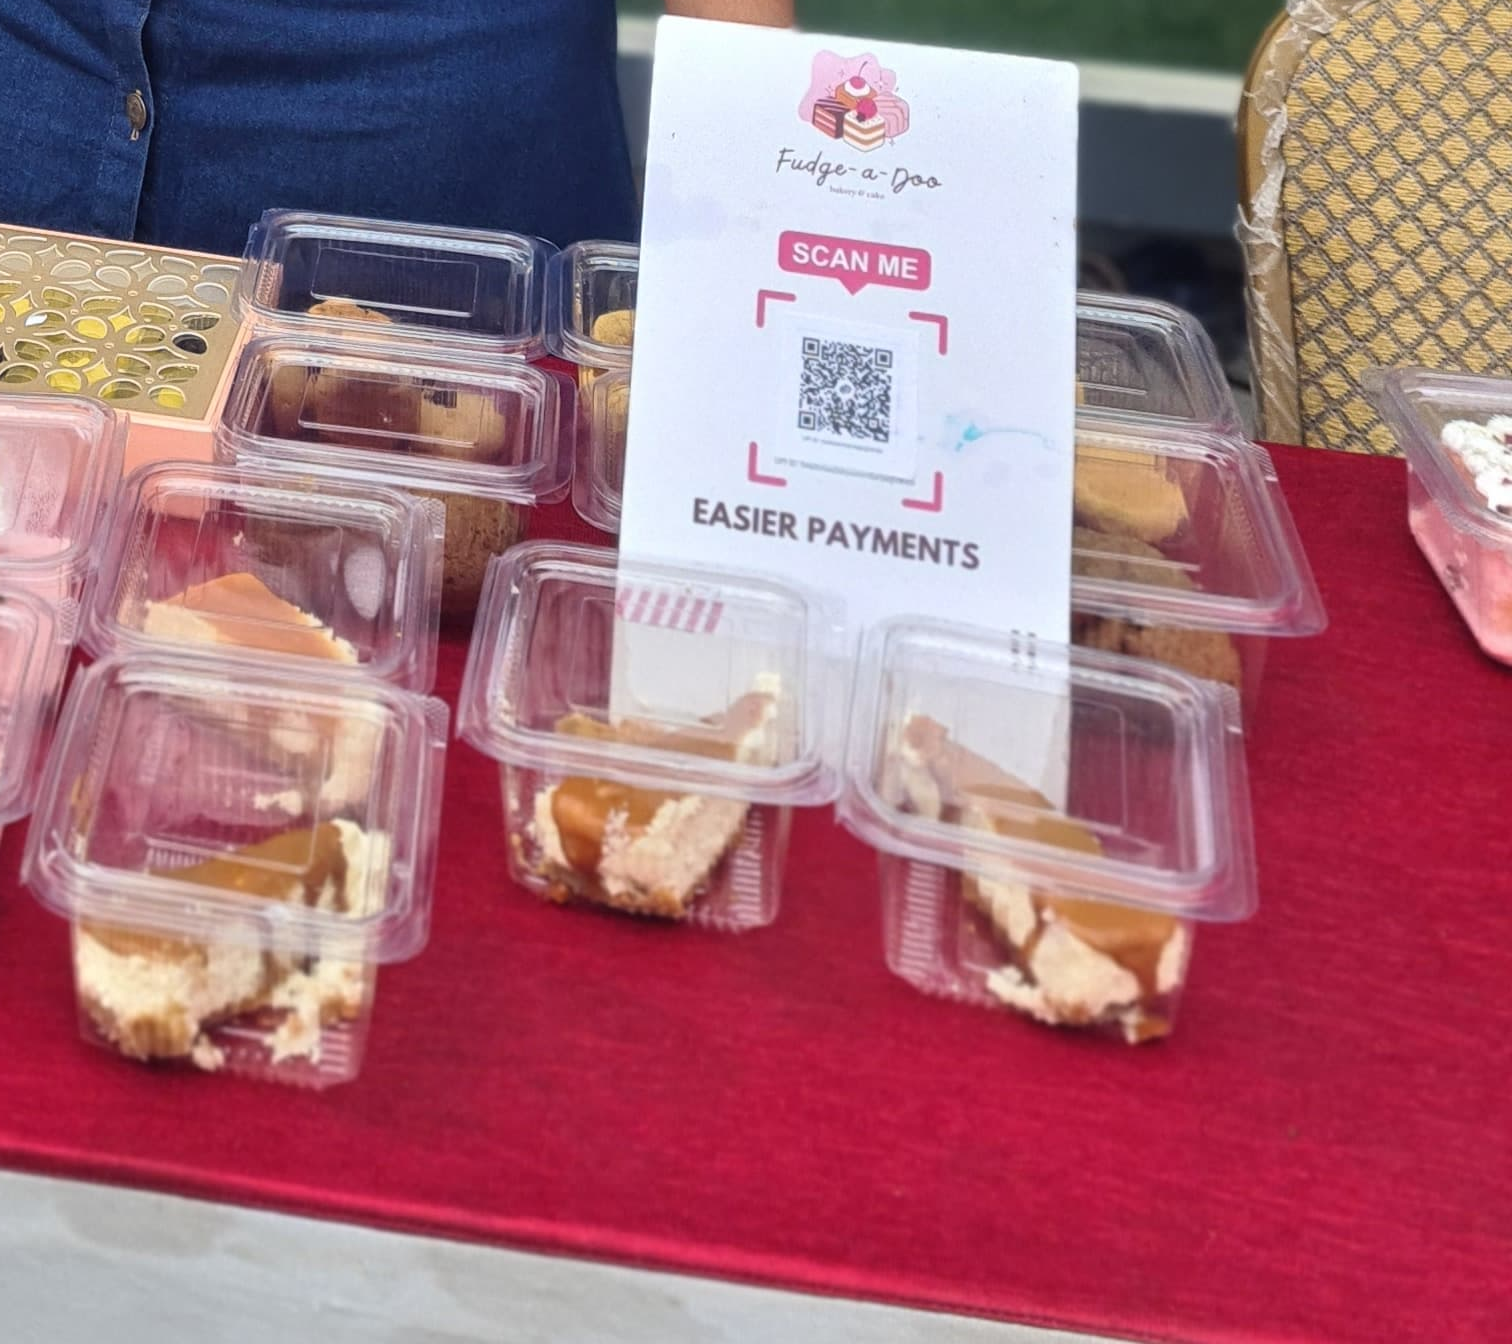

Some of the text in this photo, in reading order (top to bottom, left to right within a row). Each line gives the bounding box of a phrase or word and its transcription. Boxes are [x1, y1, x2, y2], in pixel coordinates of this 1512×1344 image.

[776, 147, 942, 193] Fudge-a-Doo
[792, 242, 918, 280] SCAN ME
[692, 496, 980, 570] EASIER PAYMENTS
